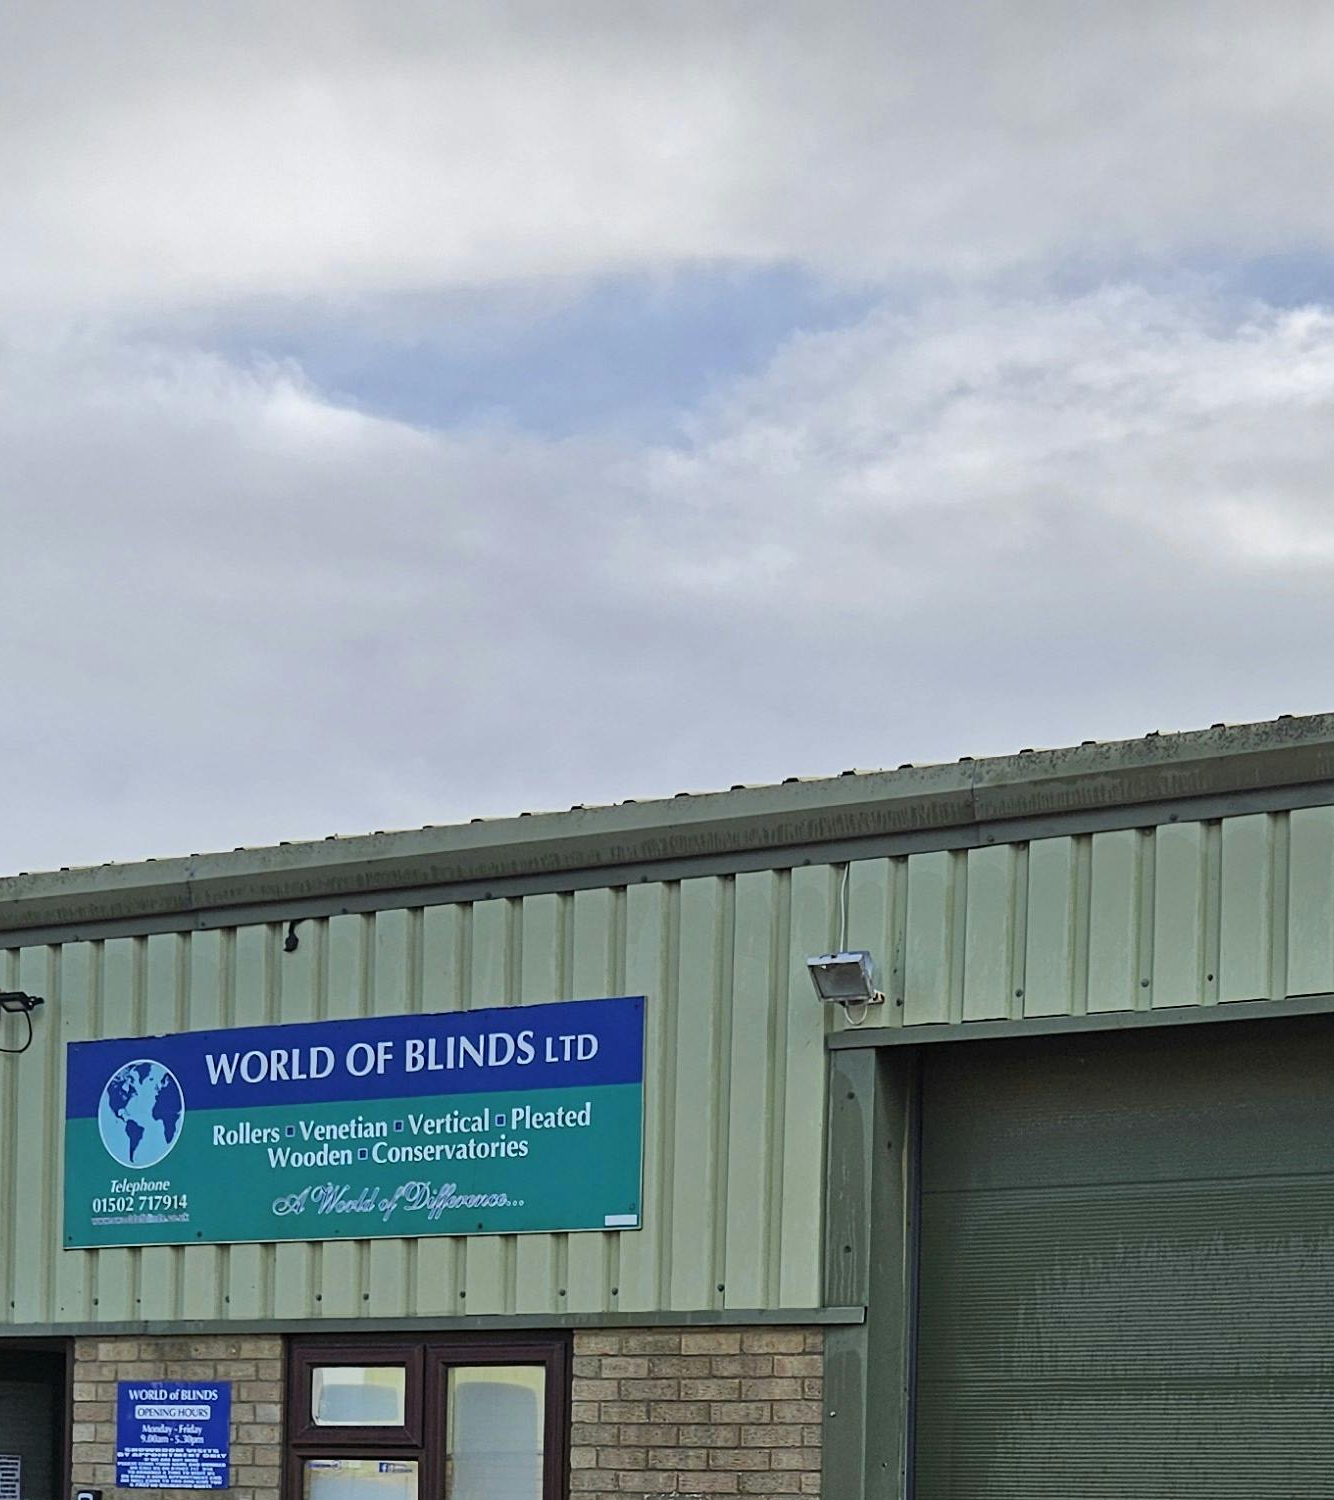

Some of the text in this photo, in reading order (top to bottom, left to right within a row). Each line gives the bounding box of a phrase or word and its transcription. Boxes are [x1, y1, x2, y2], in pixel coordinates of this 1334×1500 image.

[205, 1030, 599, 1085] WORLD OF BLINDS LTD
[213, 1102, 591, 1146] Rollers Venetian Vertical Pleated
[268, 1137, 528, 1169] Wooden Conservatories
[111, 1178, 170, 1196] Telephone
[92, 1194, 187, 1213] 01502 717914
[272, 1185, 305, 1216] A
[310, 1182, 379, 1215] World
[379, 1186, 405, 1222] of
[129, 1389, 219, 1400] WORLD of BLINDS
[137, 1408, 208, 1416] OPENING HOURS
[142, 1425, 172, 1435] Monday
[179, 1424, 203, 1435] Friday
[140, 1435, 169, 1443] 9.00am
